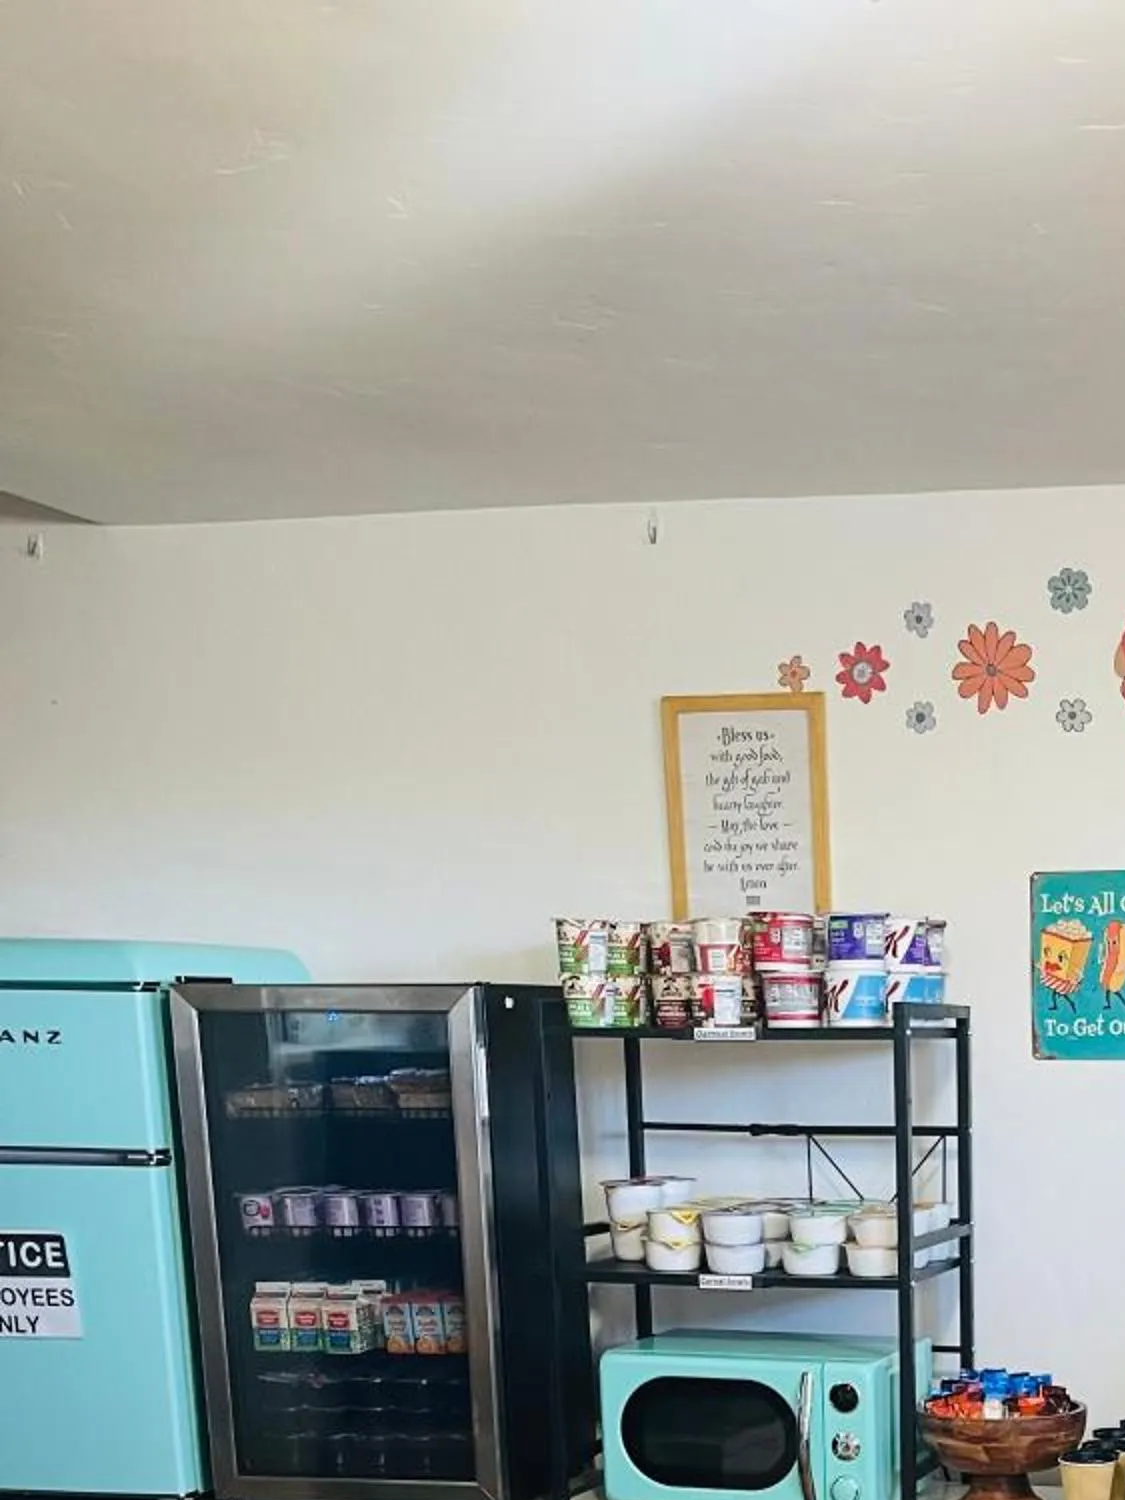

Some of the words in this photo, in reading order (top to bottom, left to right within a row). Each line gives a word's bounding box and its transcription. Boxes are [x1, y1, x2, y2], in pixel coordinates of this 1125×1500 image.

[722, 727, 752, 746] Bless
[1040, 892, 1084, 914] Let's
[1088, 891, 1115, 916] All
[1045, 1018, 1069, 1037] To
[1073, 1014, 1104, 1037] Get
